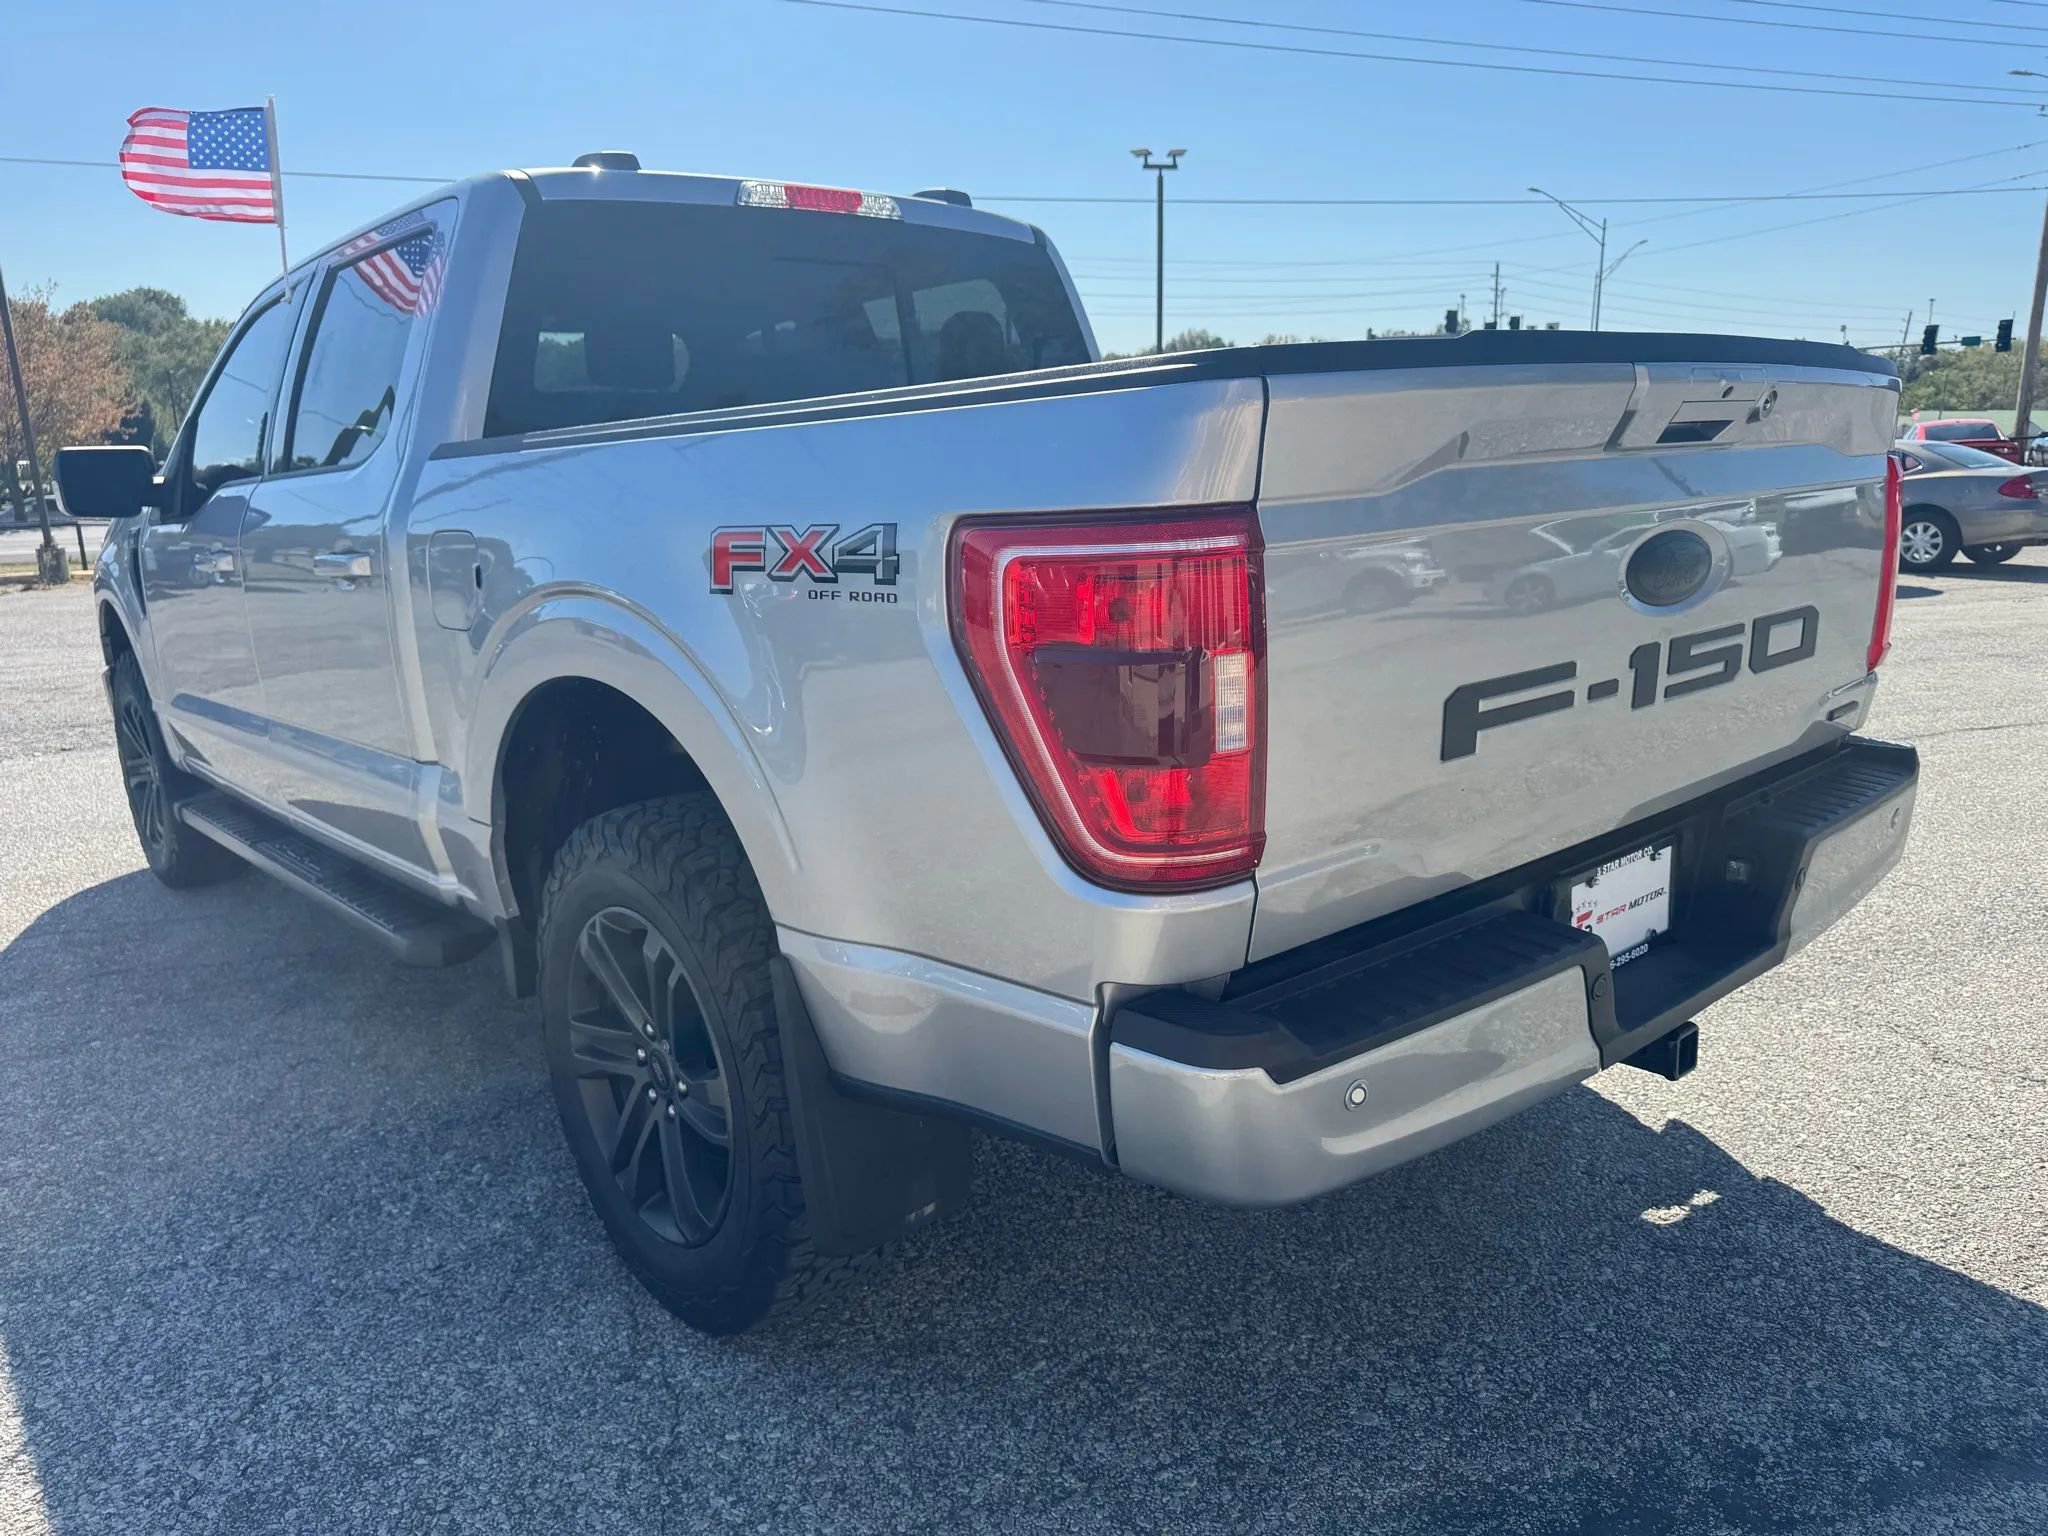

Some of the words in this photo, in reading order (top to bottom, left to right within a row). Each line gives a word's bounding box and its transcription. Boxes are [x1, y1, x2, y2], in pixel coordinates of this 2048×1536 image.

[710, 523, 900, 594] FX4
[808, 589, 841, 601] OFF
[849, 591, 898, 604] ROAD
[1441, 605, 1819, 761] F-150
[1602, 859, 1619, 874] STAR
[1620, 850, 1643, 867] MOTOR
[1596, 904, 1627, 924] STAR
[1628, 887, 1665, 910] MOTOR
